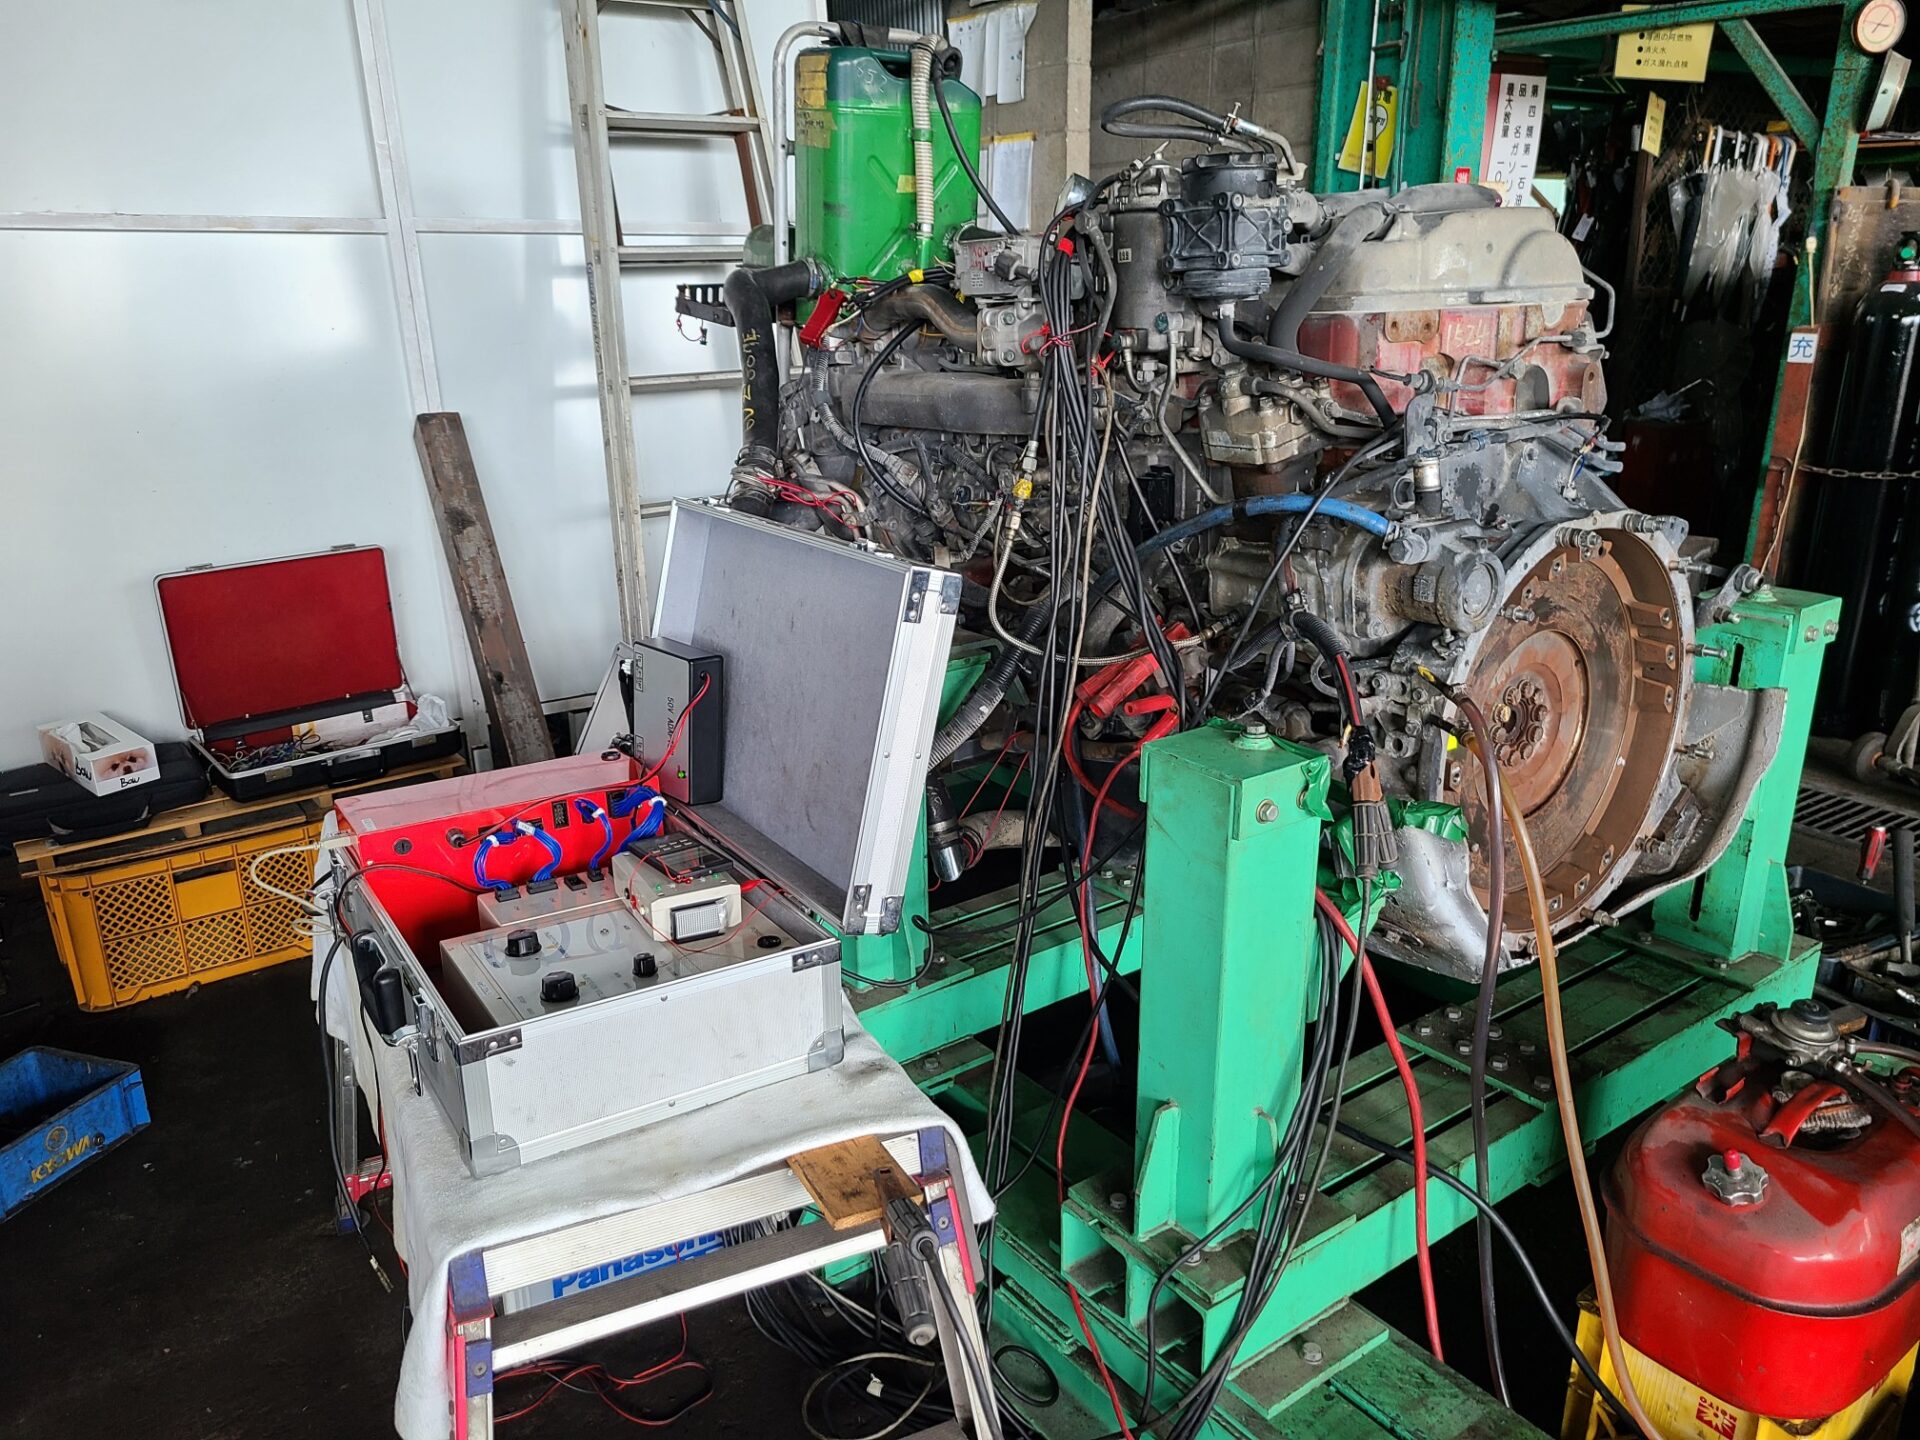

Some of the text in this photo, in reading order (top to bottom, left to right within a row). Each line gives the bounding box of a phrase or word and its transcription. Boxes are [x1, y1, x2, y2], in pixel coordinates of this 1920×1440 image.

[1790, 336, 1814, 358] 充
[119, 776, 141, 789] Bow
[31, 1135, 91, 1184] KYOWA
